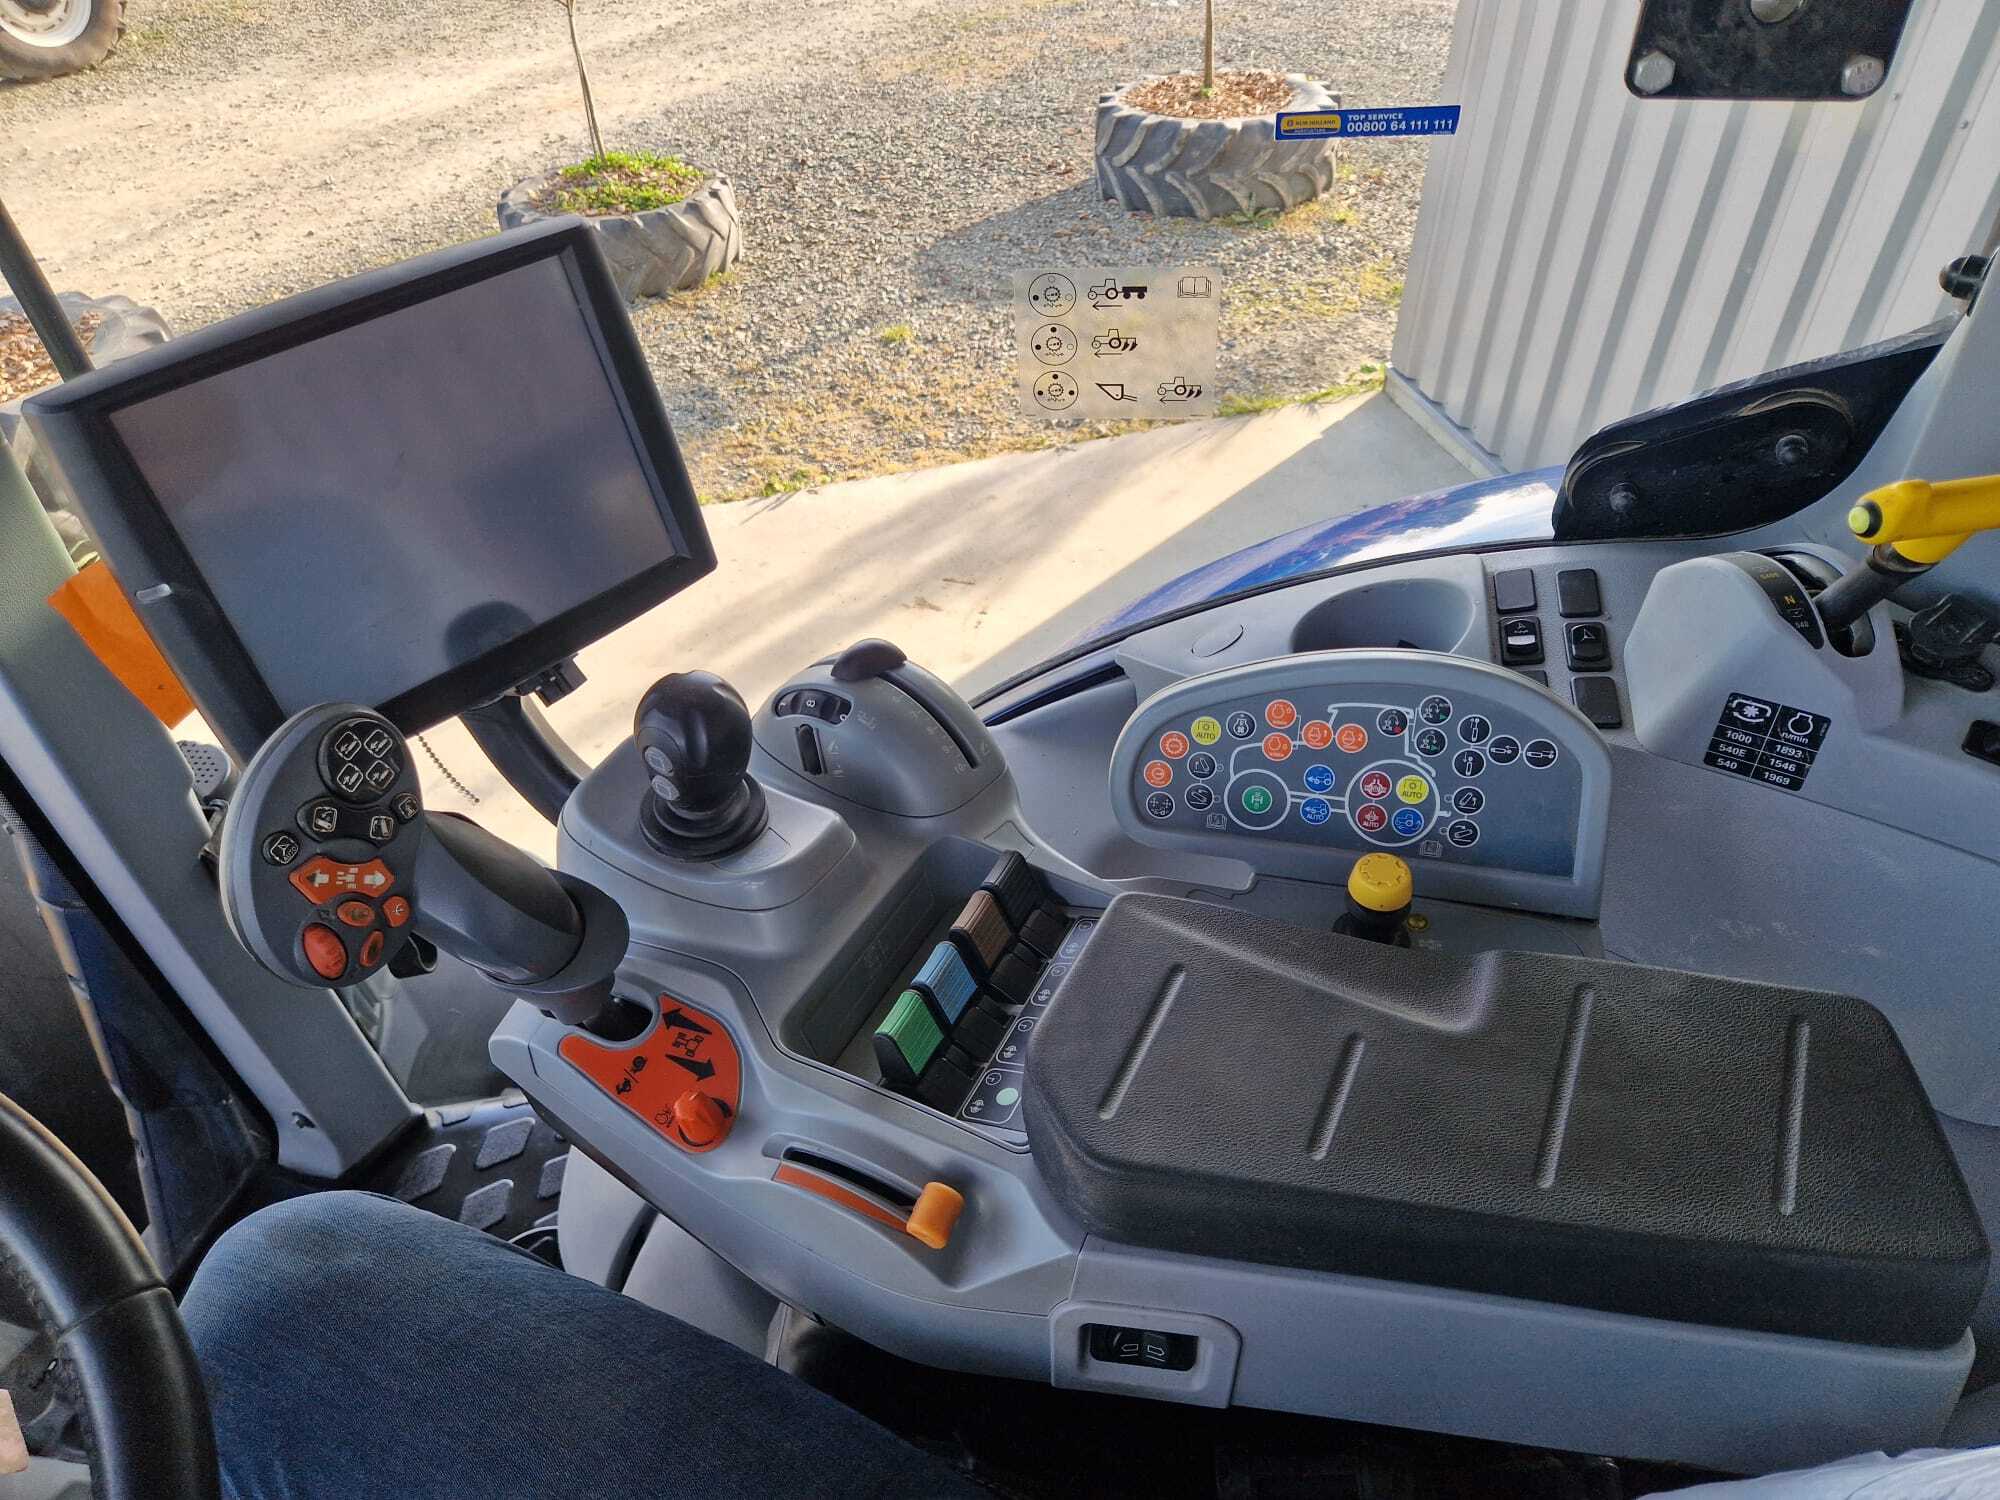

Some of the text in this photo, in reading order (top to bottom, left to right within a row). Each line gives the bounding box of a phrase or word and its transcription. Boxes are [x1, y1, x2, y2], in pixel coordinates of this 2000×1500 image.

[1347, 119, 1453, 132] 00800 64 111 111
[1784, 595, 1796, 605] N
[1196, 732, 1216, 740] AUTO
[1726, 730, 1752, 744] 1000
[1719, 743, 1748, 758] 540E
[1775, 744, 1802, 759] 1893
[1717, 758, 1738, 770] 540
[1769, 758, 1797, 772] 1546
[1764, 772, 1791, 785] 1969
[1402, 791, 1423, 799] AUTO
